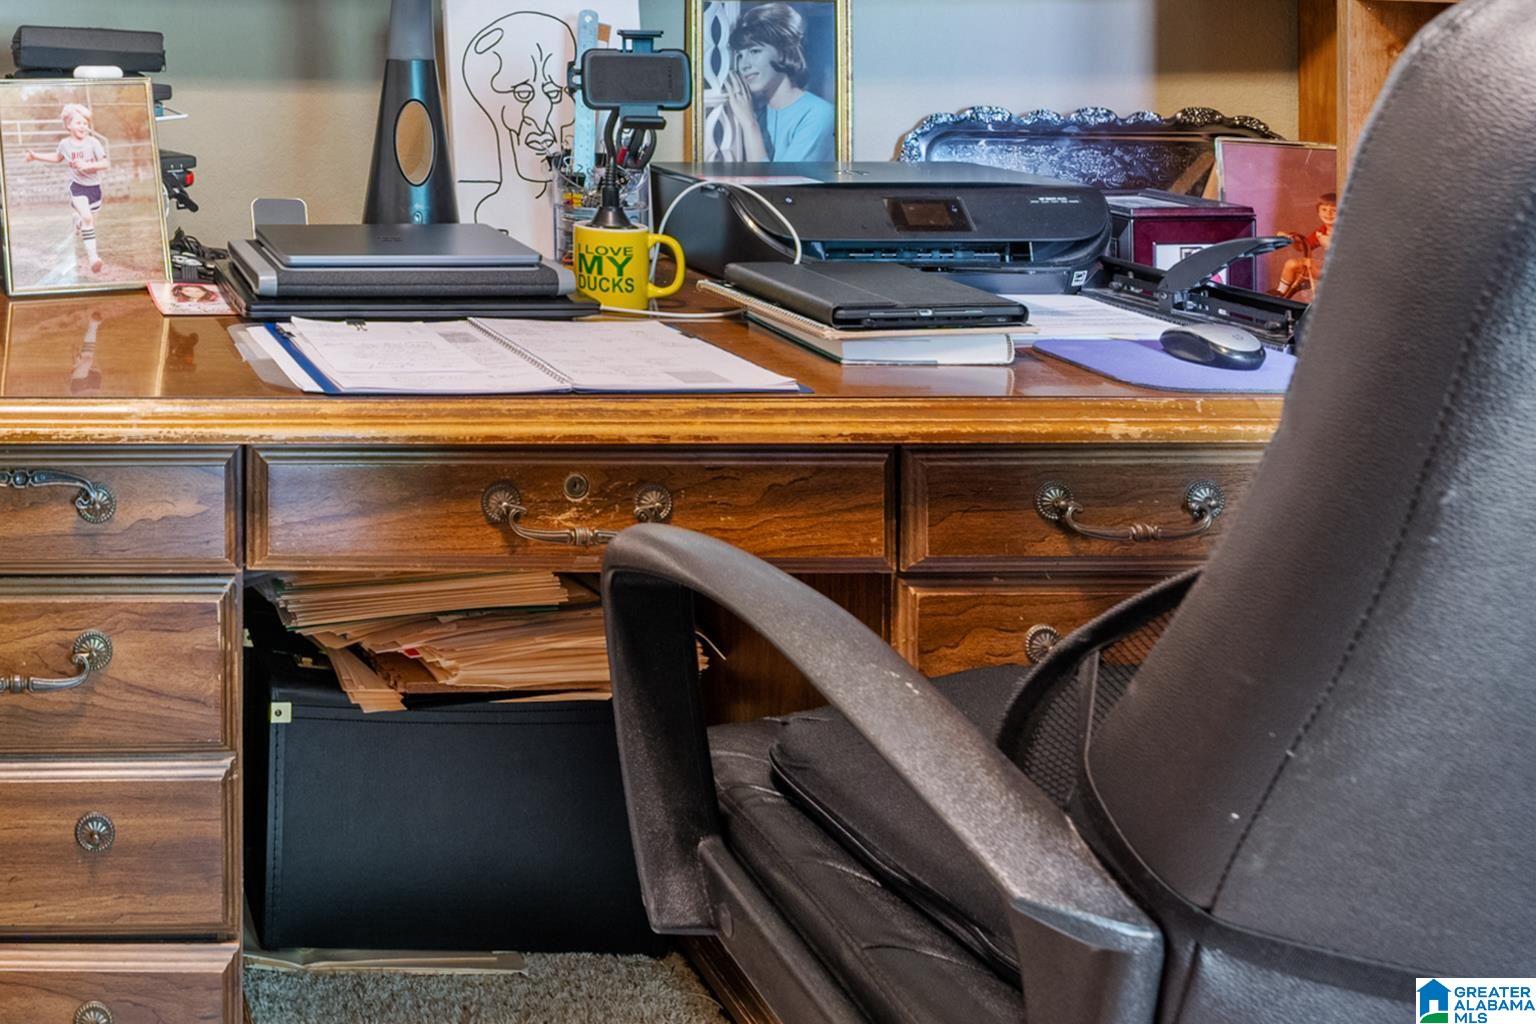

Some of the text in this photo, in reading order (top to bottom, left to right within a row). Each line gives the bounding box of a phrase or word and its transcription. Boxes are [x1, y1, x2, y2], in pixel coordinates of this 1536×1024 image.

[585, 244, 634, 256] LOVE
[578, 252, 633, 277] MY
[578, 274, 635, 293] DUCKS
